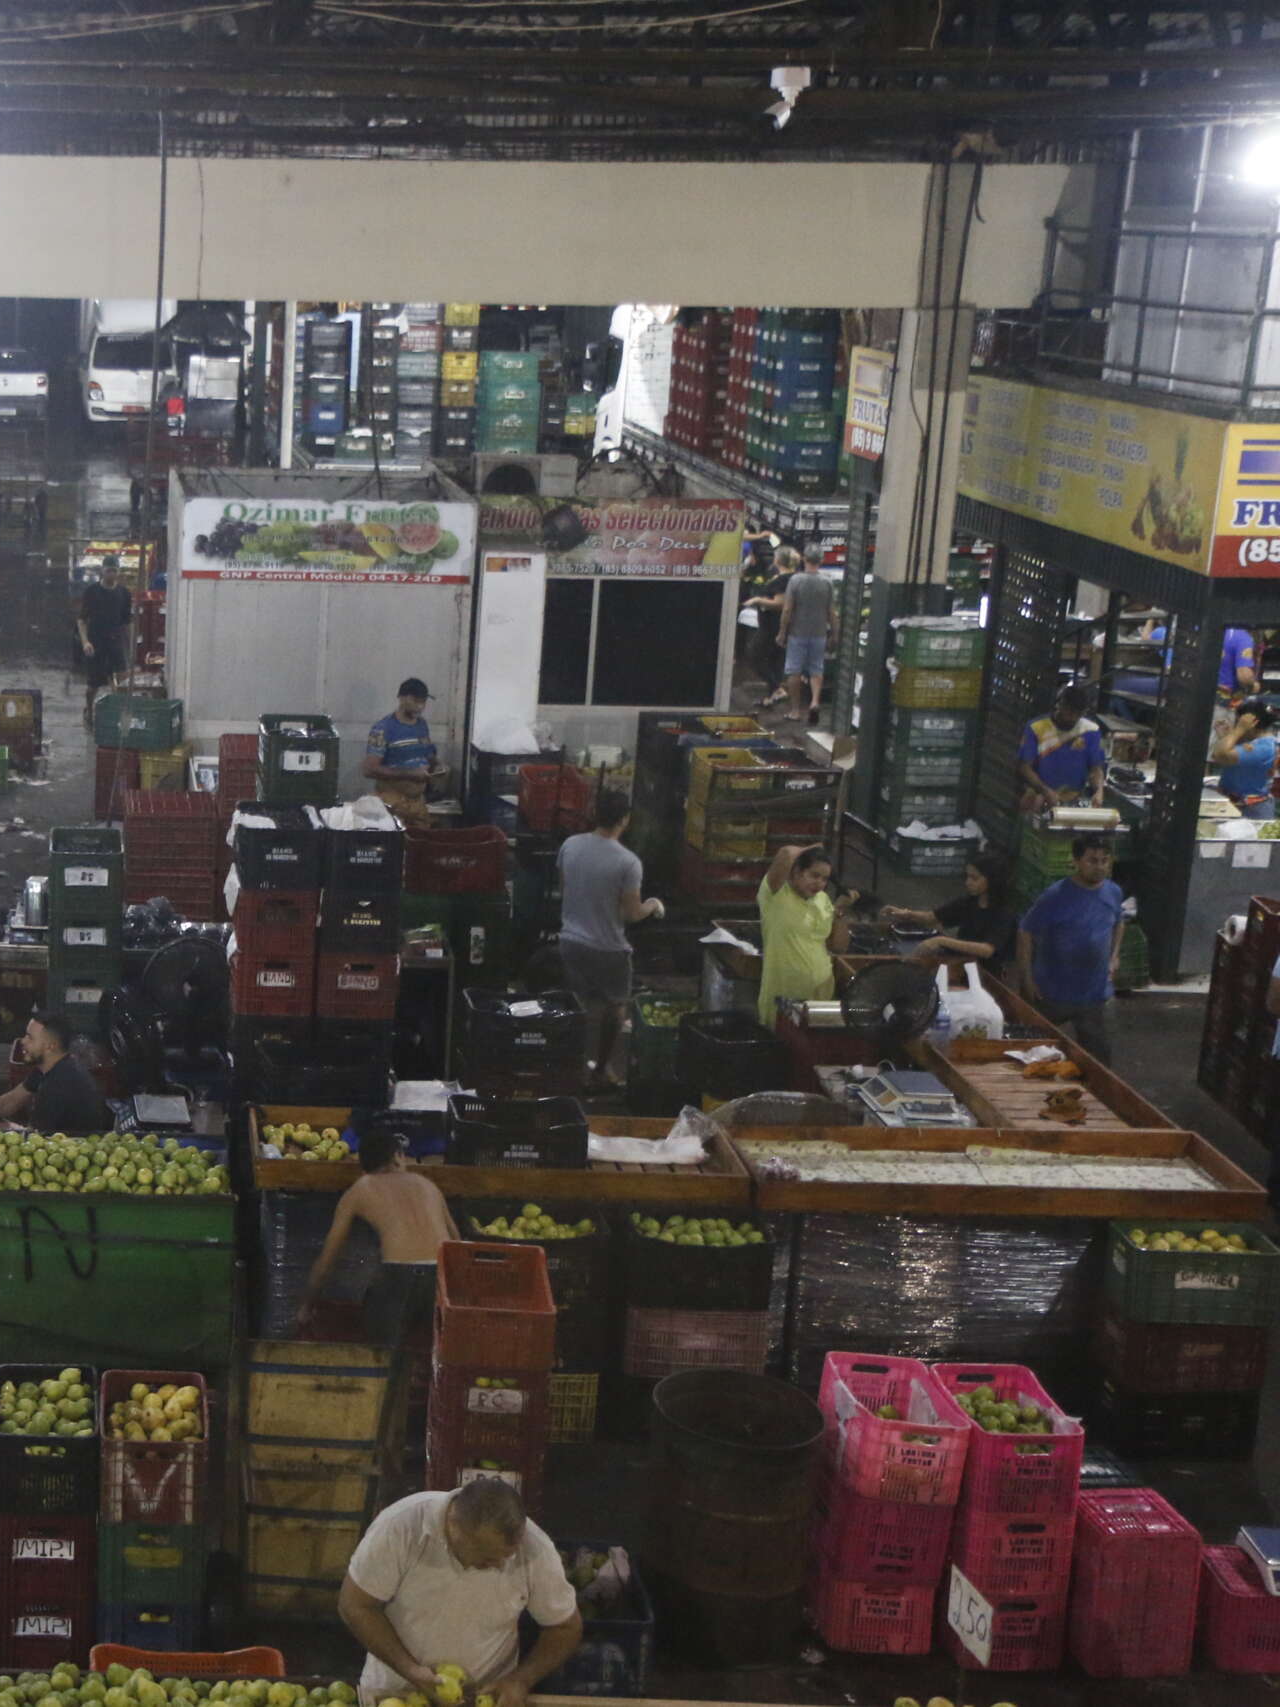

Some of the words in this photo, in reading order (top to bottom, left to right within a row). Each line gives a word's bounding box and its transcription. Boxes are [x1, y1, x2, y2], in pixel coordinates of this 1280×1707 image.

[223, 502, 334, 525] Ozimar
[606, 505, 739, 533] Selecionadas
[612, 535, 648, 551] Por
[219, 572, 252, 580] GNP
[256, 572, 305, 581] Central
[309, 572, 365, 583] Módulo
[21, 1617, 68, 1634] MIP
